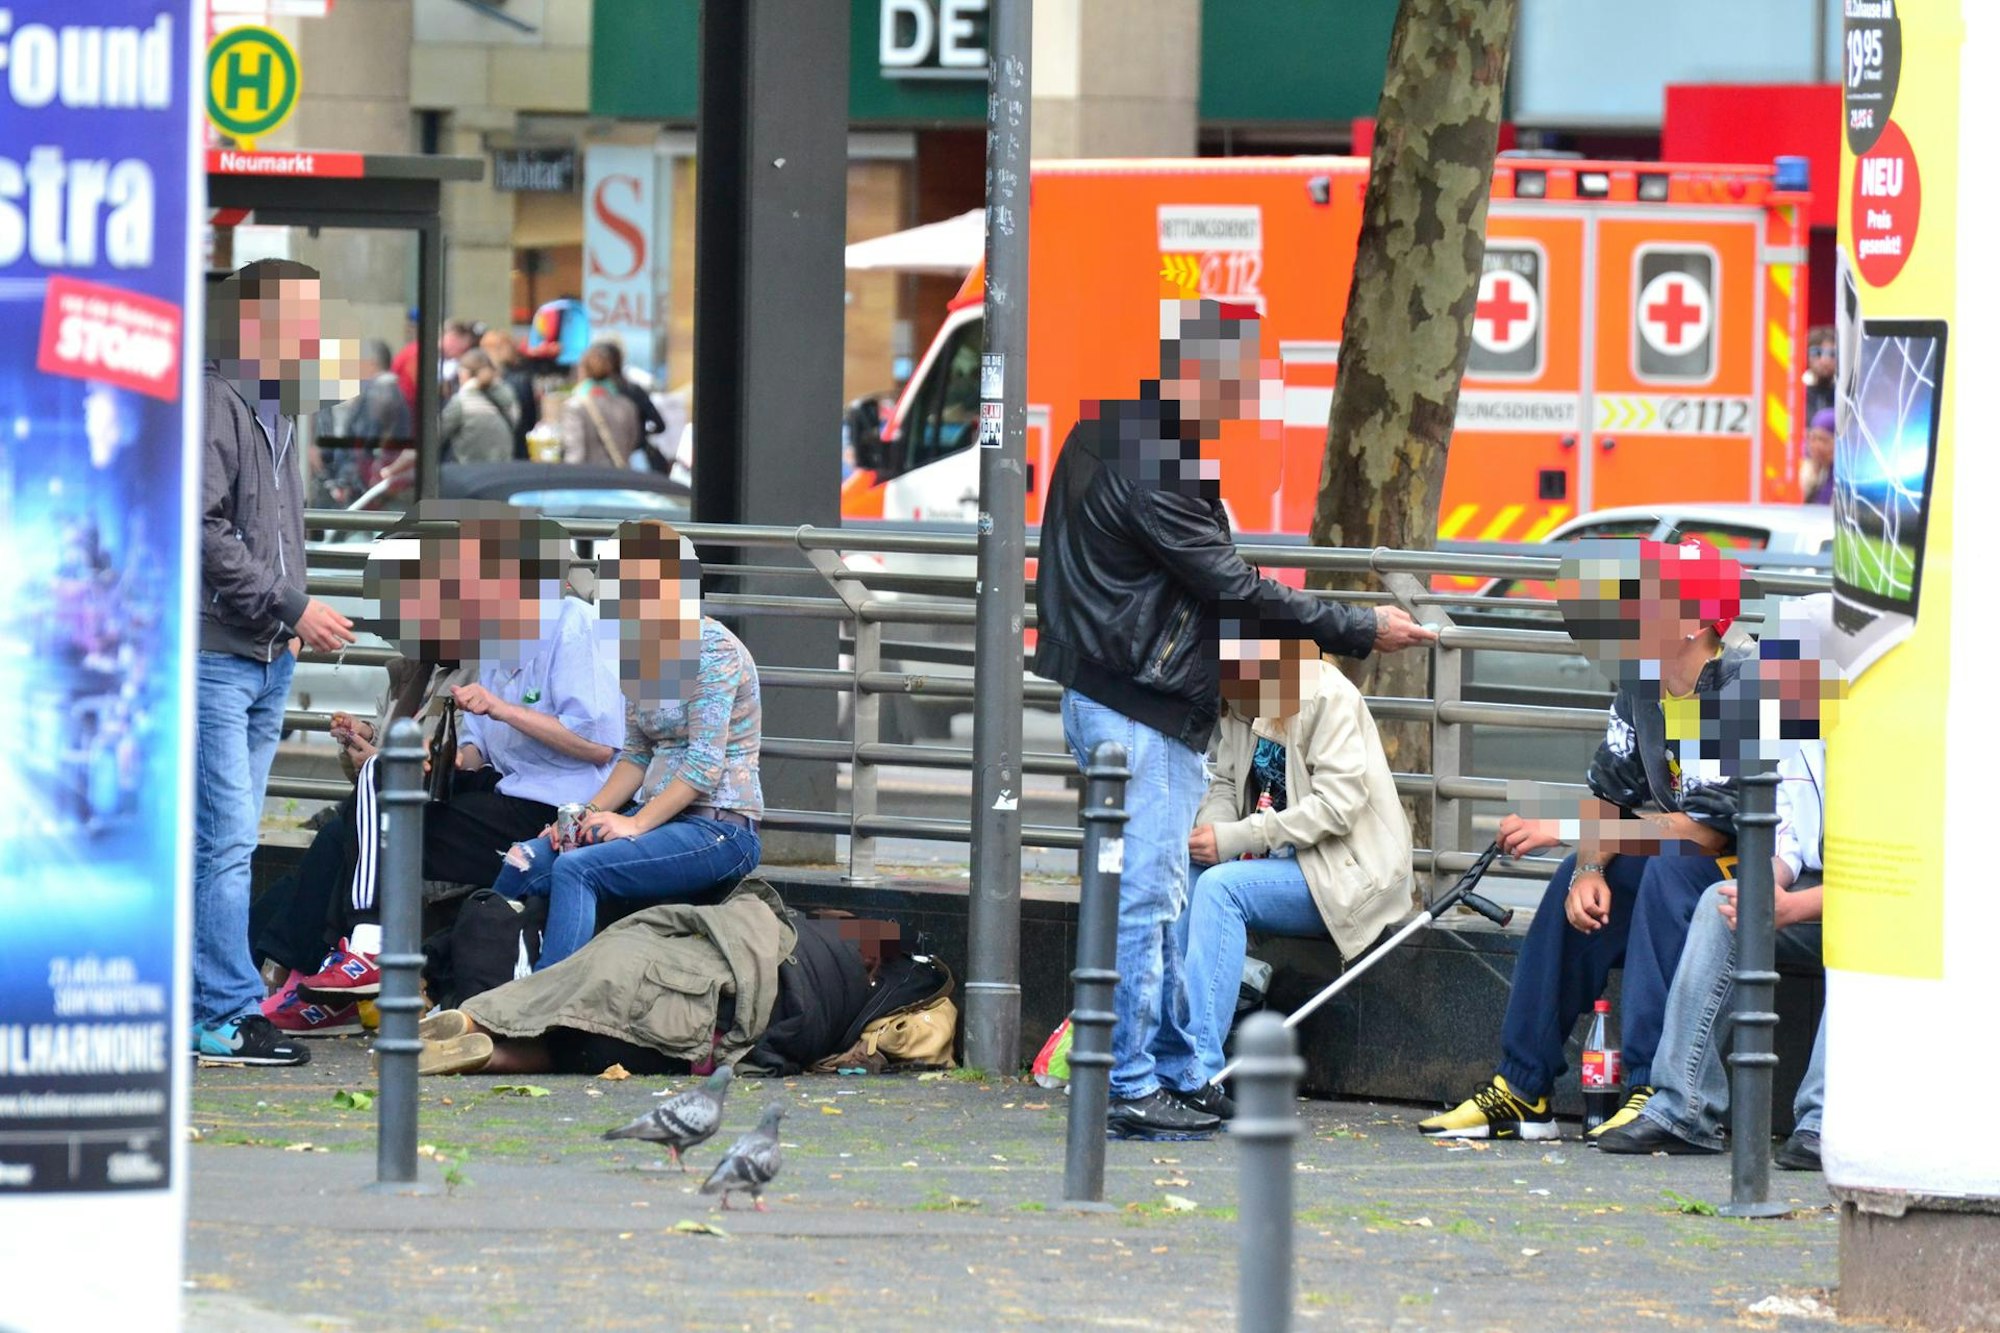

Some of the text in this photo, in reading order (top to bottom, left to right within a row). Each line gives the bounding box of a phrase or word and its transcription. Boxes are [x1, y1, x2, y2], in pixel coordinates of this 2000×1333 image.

[0, 8, 173, 109] ound
[225, 53, 272, 110] H
[220, 153, 314, 174] Neumarkt
[1861, 157, 1904, 197] NEU
[590, 172, 647, 282] S
[1867, 209, 1892, 229] Preis
[1696, 400, 1749, 432] 112
